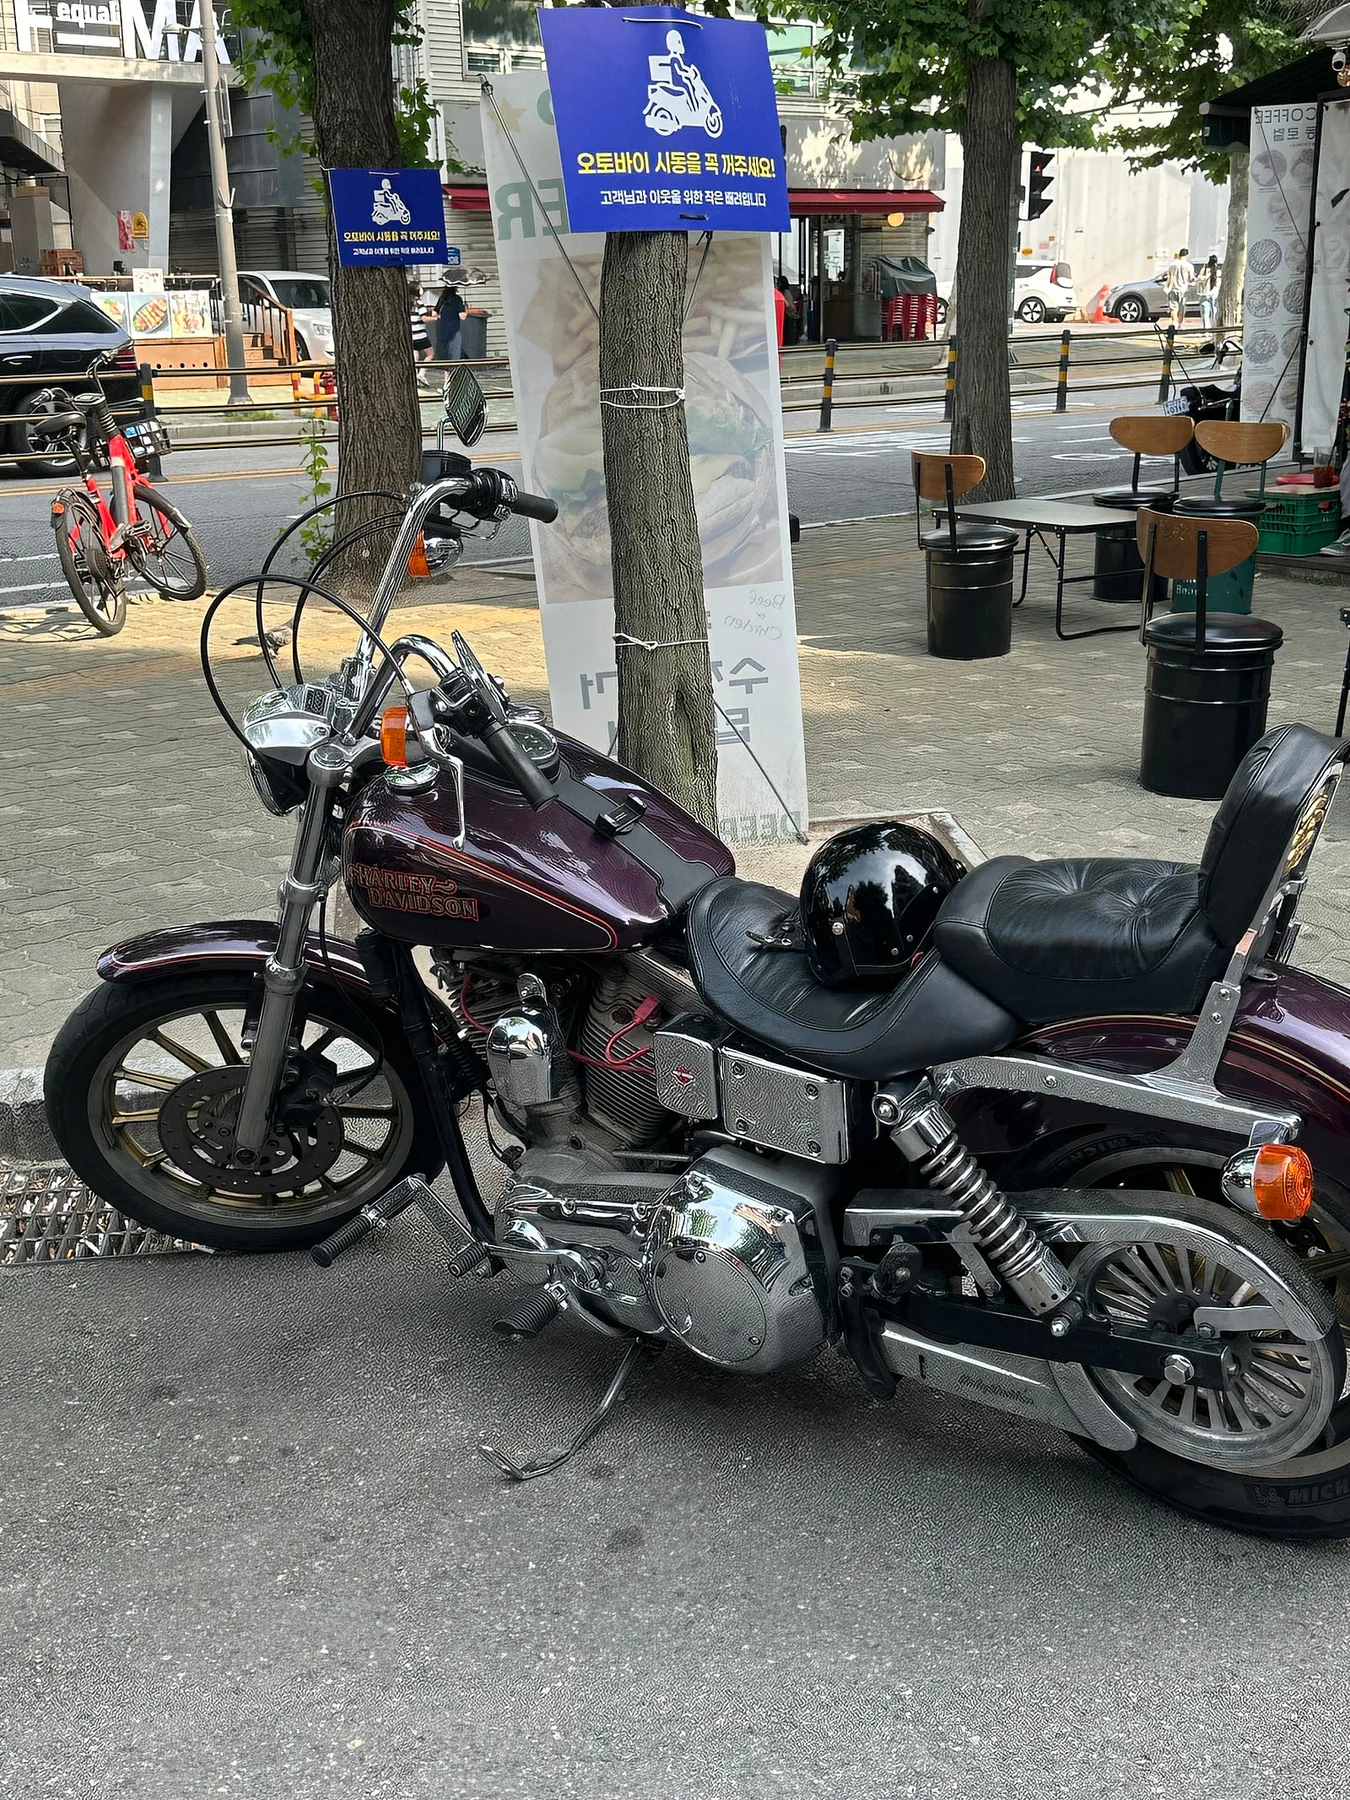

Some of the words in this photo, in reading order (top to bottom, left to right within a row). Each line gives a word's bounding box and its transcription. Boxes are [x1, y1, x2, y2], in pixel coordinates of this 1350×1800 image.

[577, 152, 650, 175] 오토바이
[655, 152, 702, 175] 시동을
[704, 153, 719, 175] 꼭
[721, 154, 776, 178] 꺼주세요!
[600, 190, 648, 205] 고객님과
[650, 190, 682, 205] 이웃을
[683, 191, 703, 206] 위한
[705, 192, 725, 206] 작은
[725, 192, 767, 207] 배려입니다
[349, 863, 448, 896] HARLEY
[369, 886, 479, 921] DAVIDSON
